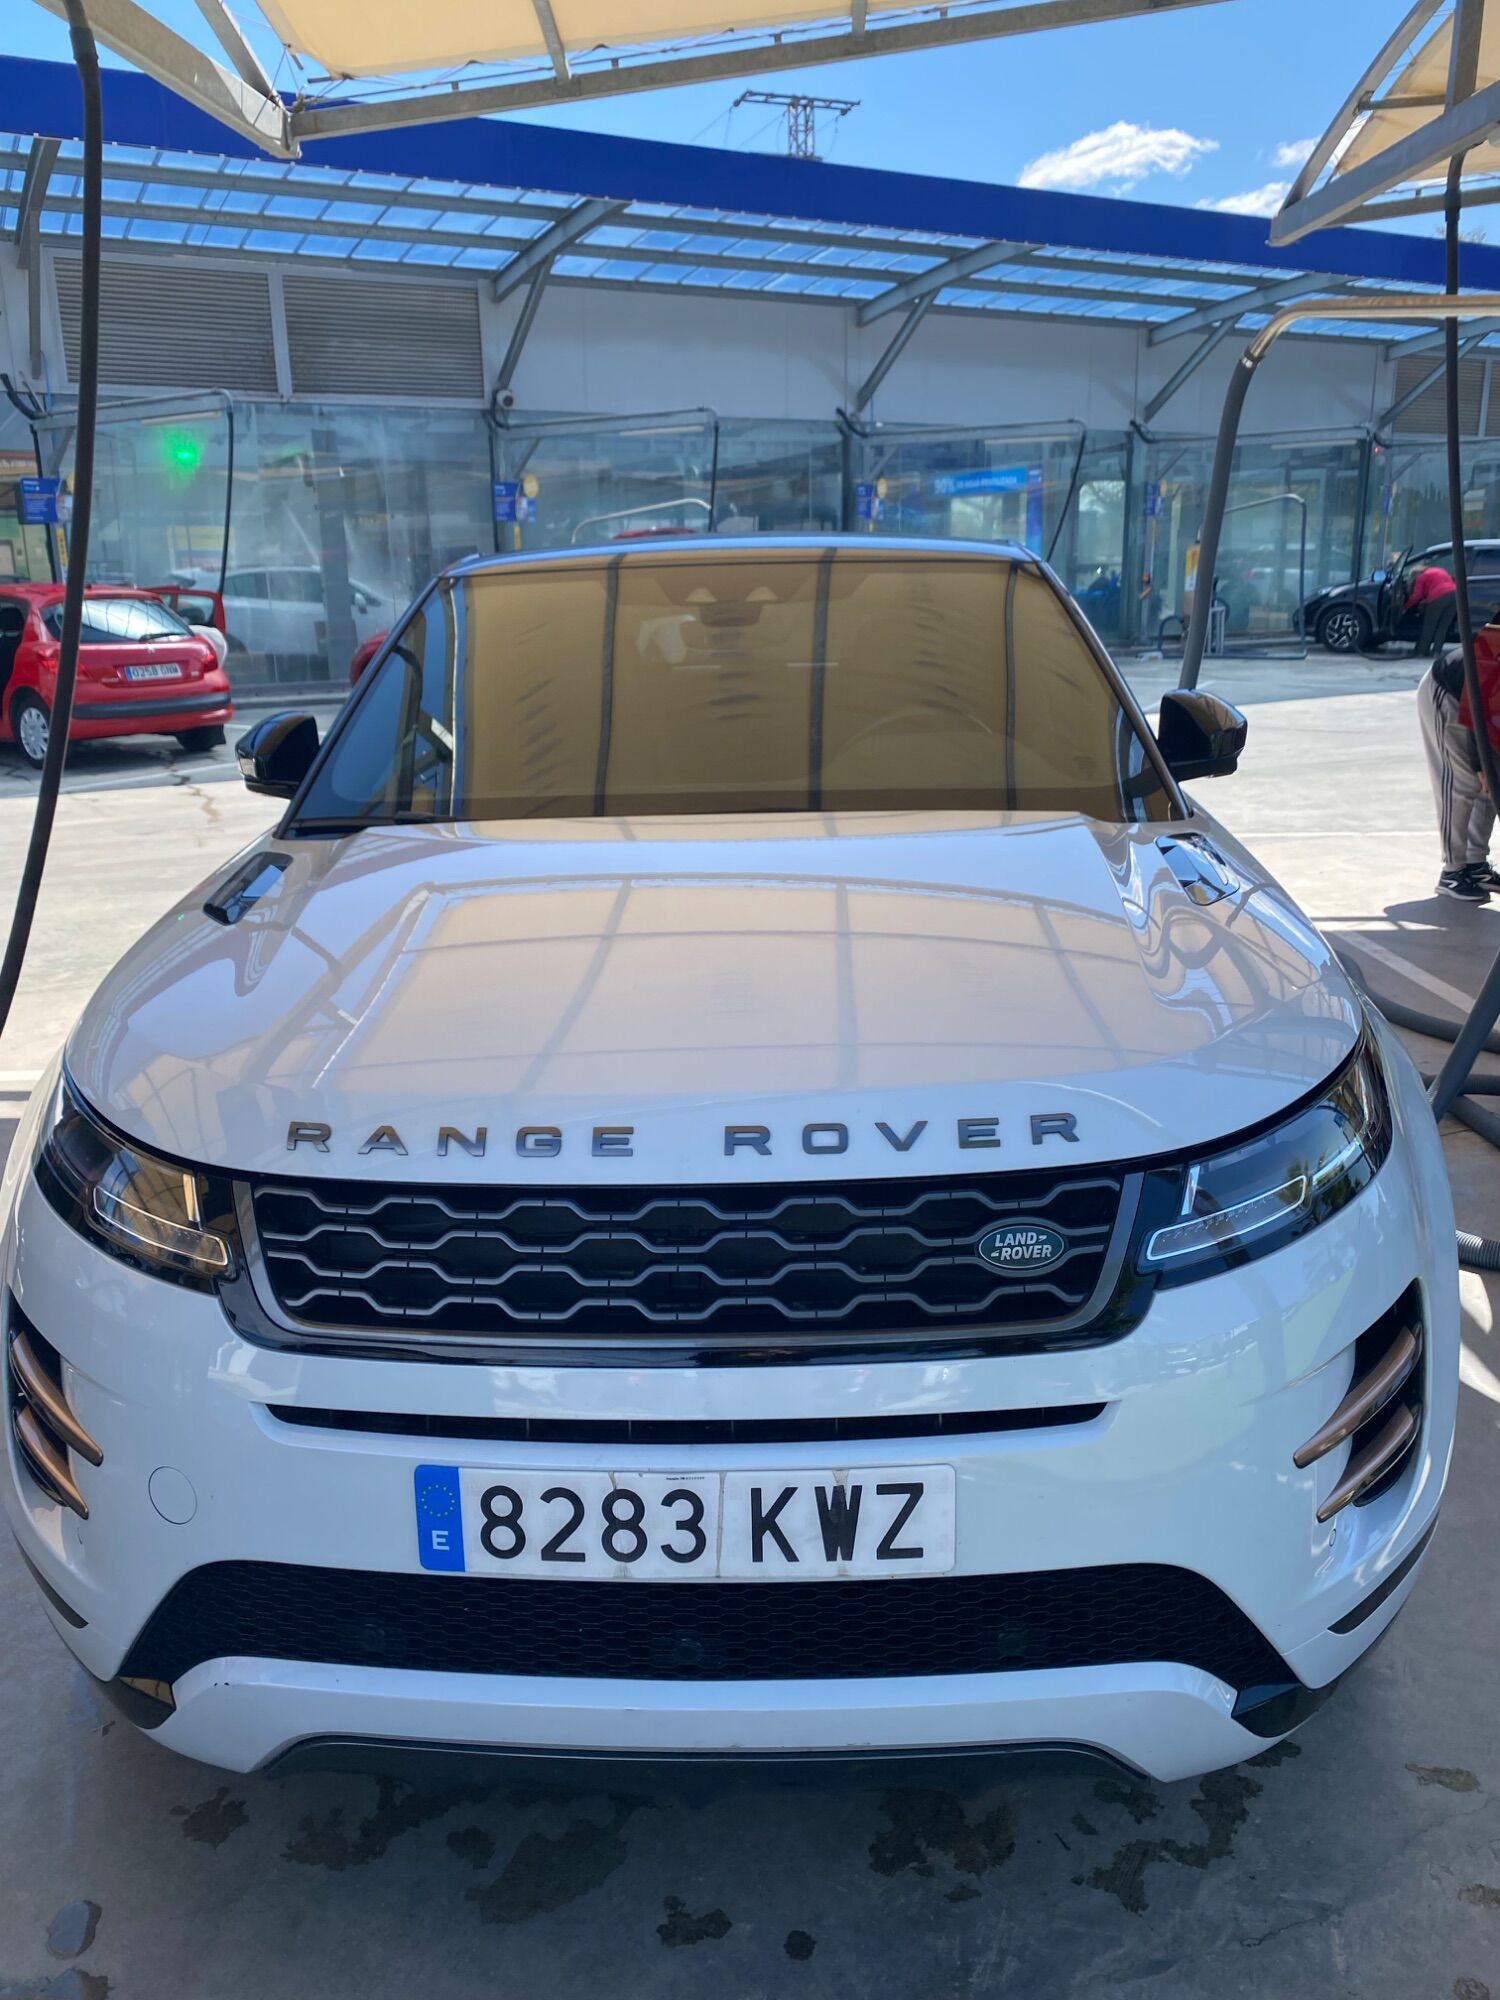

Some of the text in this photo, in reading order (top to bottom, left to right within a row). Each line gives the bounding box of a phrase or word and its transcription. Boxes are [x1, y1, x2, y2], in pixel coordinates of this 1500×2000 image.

[286, 1112, 1080, 1158] RANGE ROVER
[994, 1231, 1038, 1248] LAND
[1000, 1244, 1053, 1261] ROVER
[479, 1482, 925, 1564] 8283 KWZ
[431, 1530, 450, 1551] E
